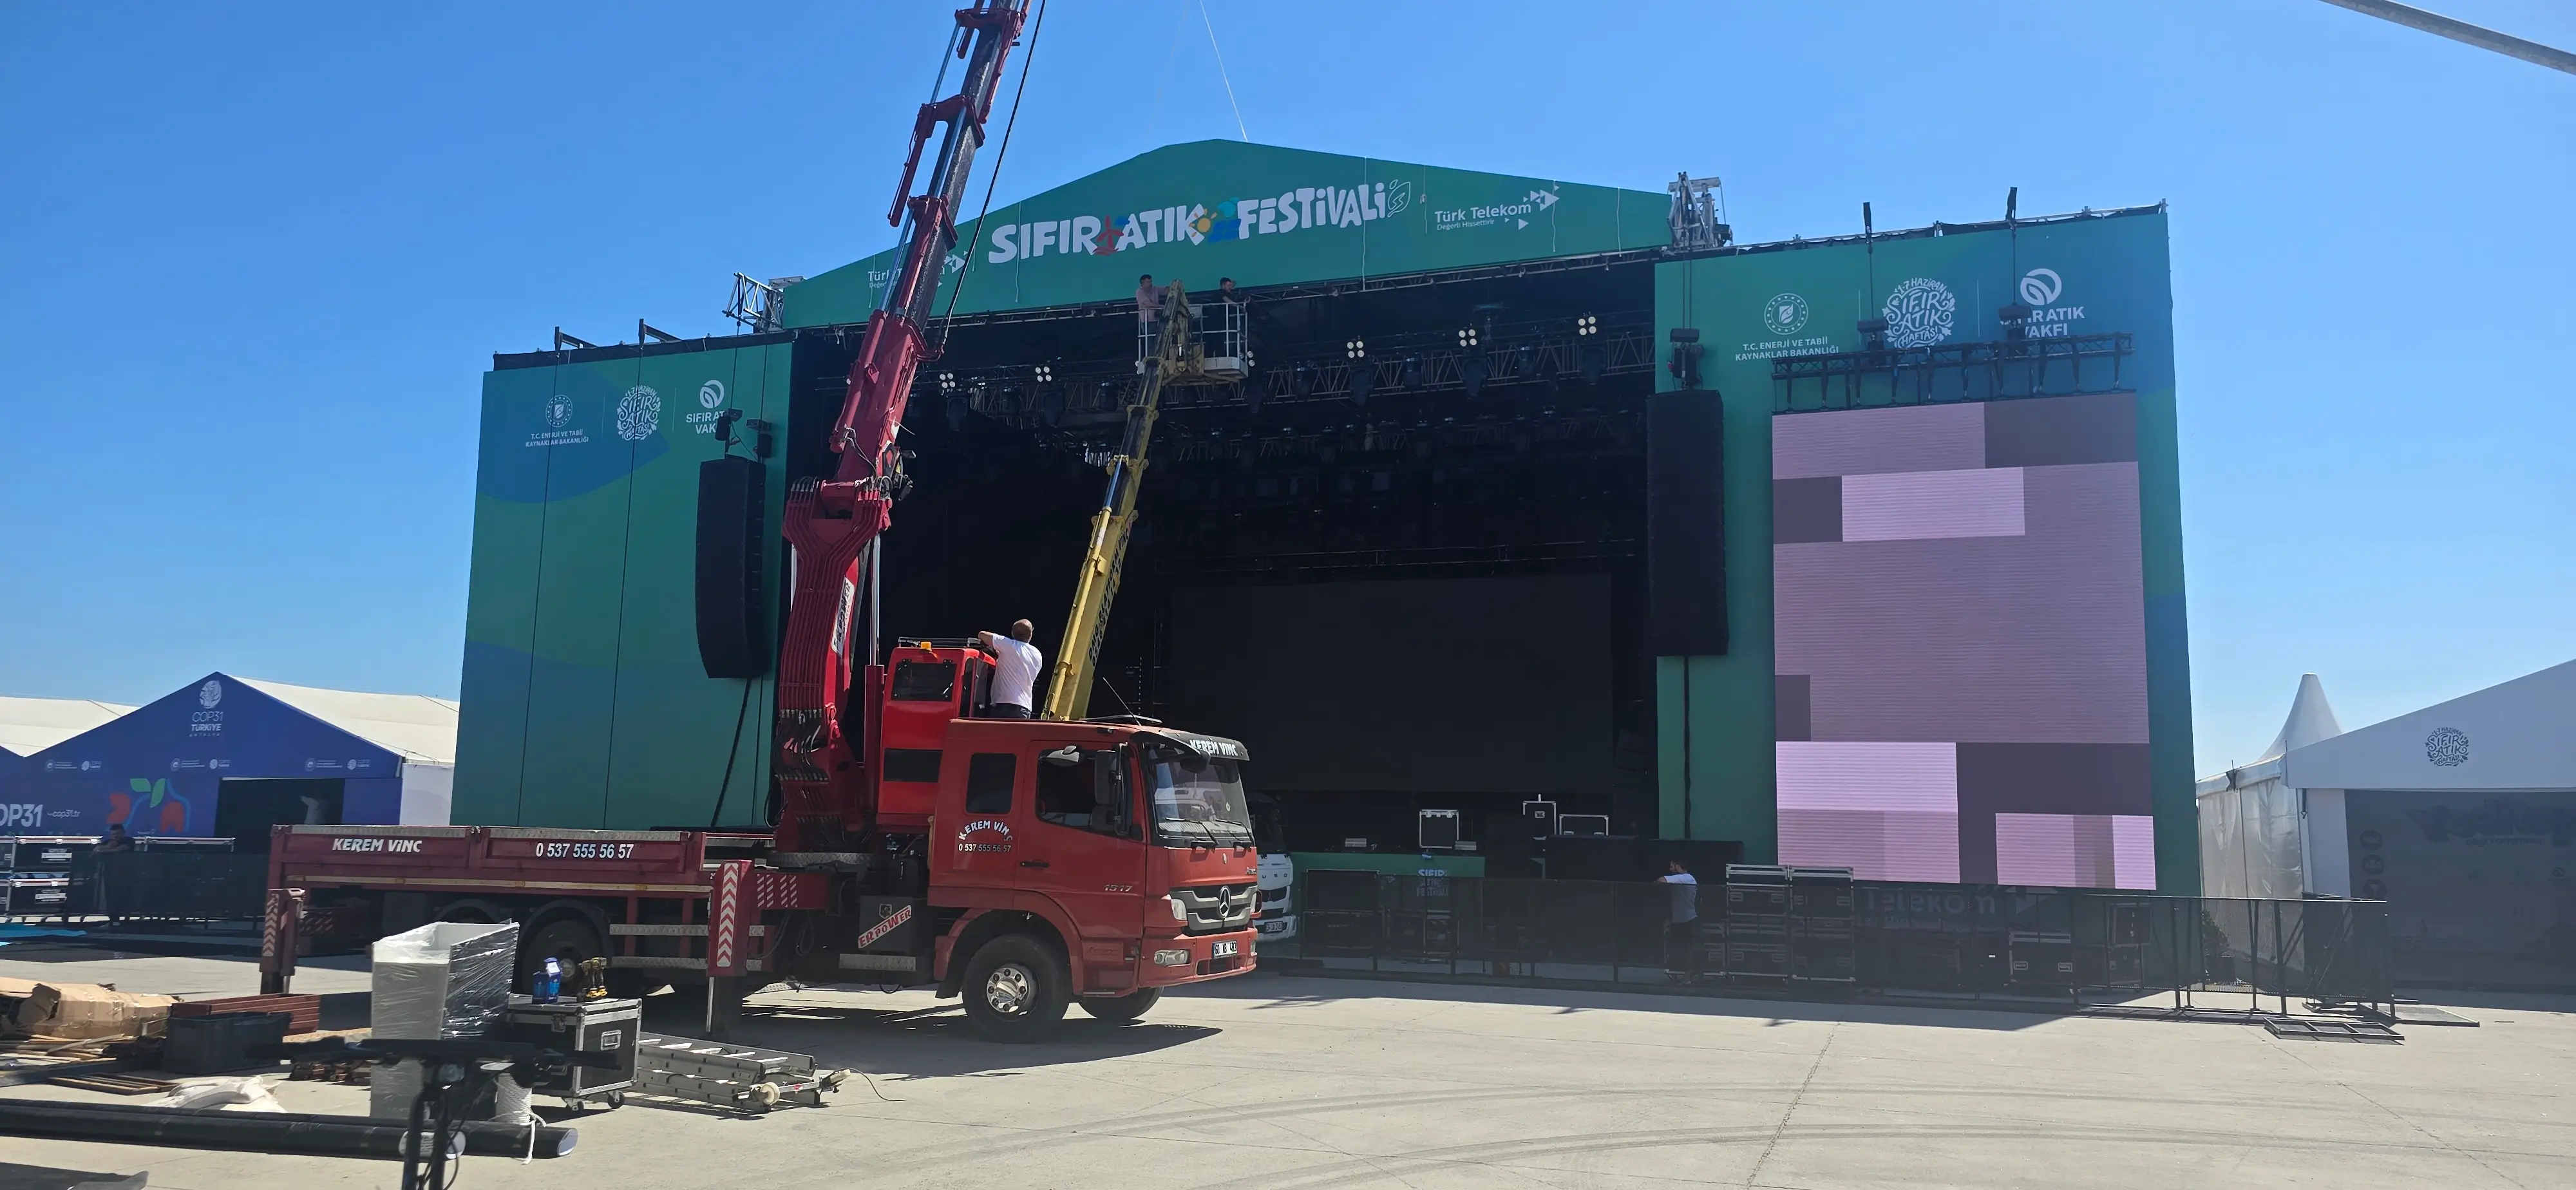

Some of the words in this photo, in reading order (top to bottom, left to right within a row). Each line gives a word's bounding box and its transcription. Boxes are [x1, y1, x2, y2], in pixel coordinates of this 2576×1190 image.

[1435, 208, 1466, 223] Türk
[1470, 203, 1531, 219] Telekom
[989, 220, 1099, 263] SIFIR
[1115, 203, 1205, 252] ATIK
[1437, 222, 1461, 231] Değerli
[1462, 220, 1495, 228] Hissettirir
[1911, 278, 1947, 293] HAZİRAN
[1886, 288, 1949, 324] SIFIR
[2046, 306, 2085, 321] ATIK
[1893, 309, 1951, 334] ATIK
[1743, 343, 1758, 351] T.C.
[1760, 339, 1790, 350] ENERJİ
[1792, 339, 1803, 347] VE
[1898, 326, 1938, 348] HAFTASI
[1736, 350, 1788, 361] KAYNAKLAR
[1790, 345, 1839, 357] BAKANLIĞI
[622, 410, 658, 429] ATIK
[686, 411, 712, 423] SIFIR
[712, 411, 725, 421] AT
[696, 422, 716, 434] VAK
[192, 711, 224, 722] COP31
[2427, 733, 2466, 752] SIFIR
[2432, 745, 2467, 758] ATIK
[958, 820, 990, 840] KEREM
[332, 838, 384, 853] KEREM
[536, 842, 544, 857] 0
[547, 843, 570, 857] 537
[573, 844, 596, 858] 555
[599, 844, 615, 858] 56
[618, 844, 634, 858] 57
[958, 843, 963, 851] 0
[859, 909, 911, 947] ERPOWER
